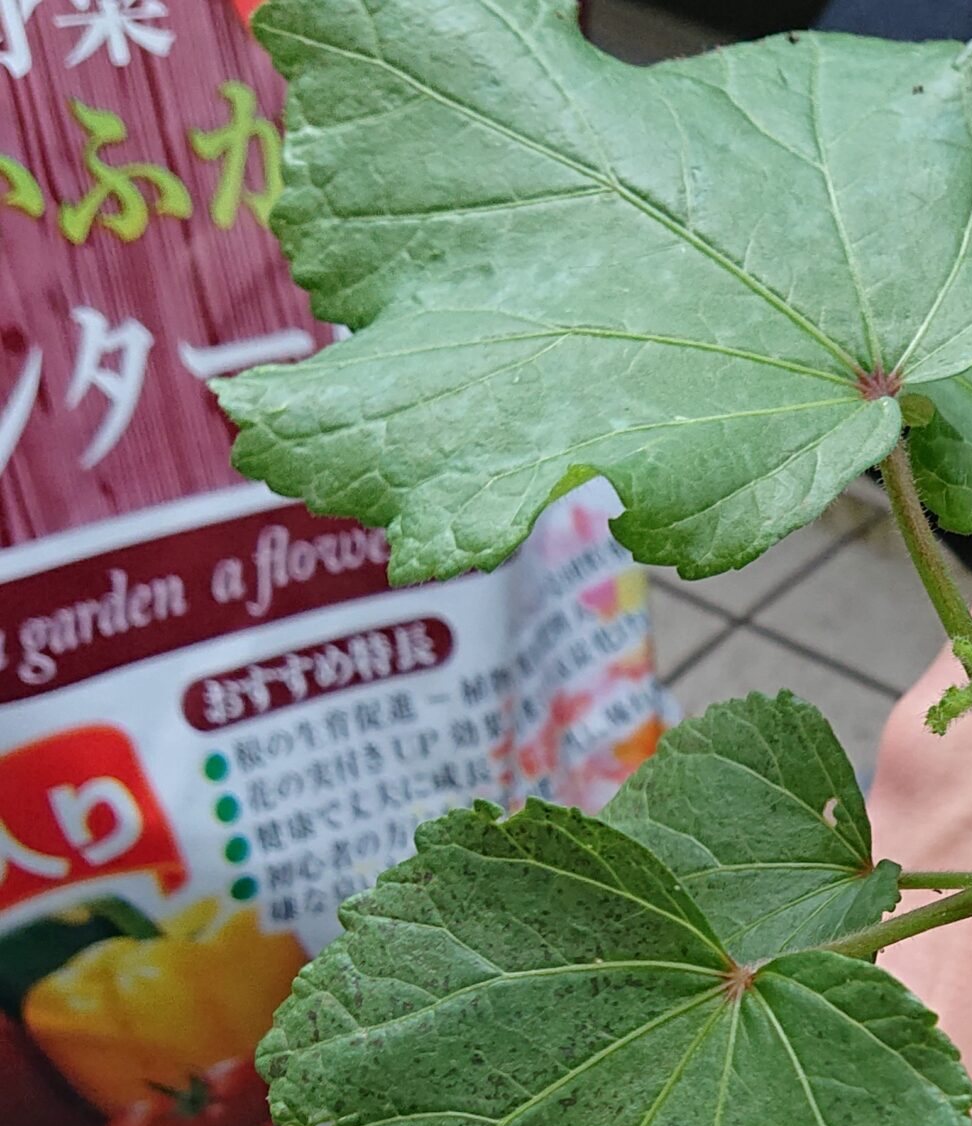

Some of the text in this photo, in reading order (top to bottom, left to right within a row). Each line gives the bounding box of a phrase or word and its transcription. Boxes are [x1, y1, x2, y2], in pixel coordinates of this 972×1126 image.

[0, 305, 352, 470] ター
[17, 566, 187, 685] garden
[202, 618, 438, 725] おすすめ特長
